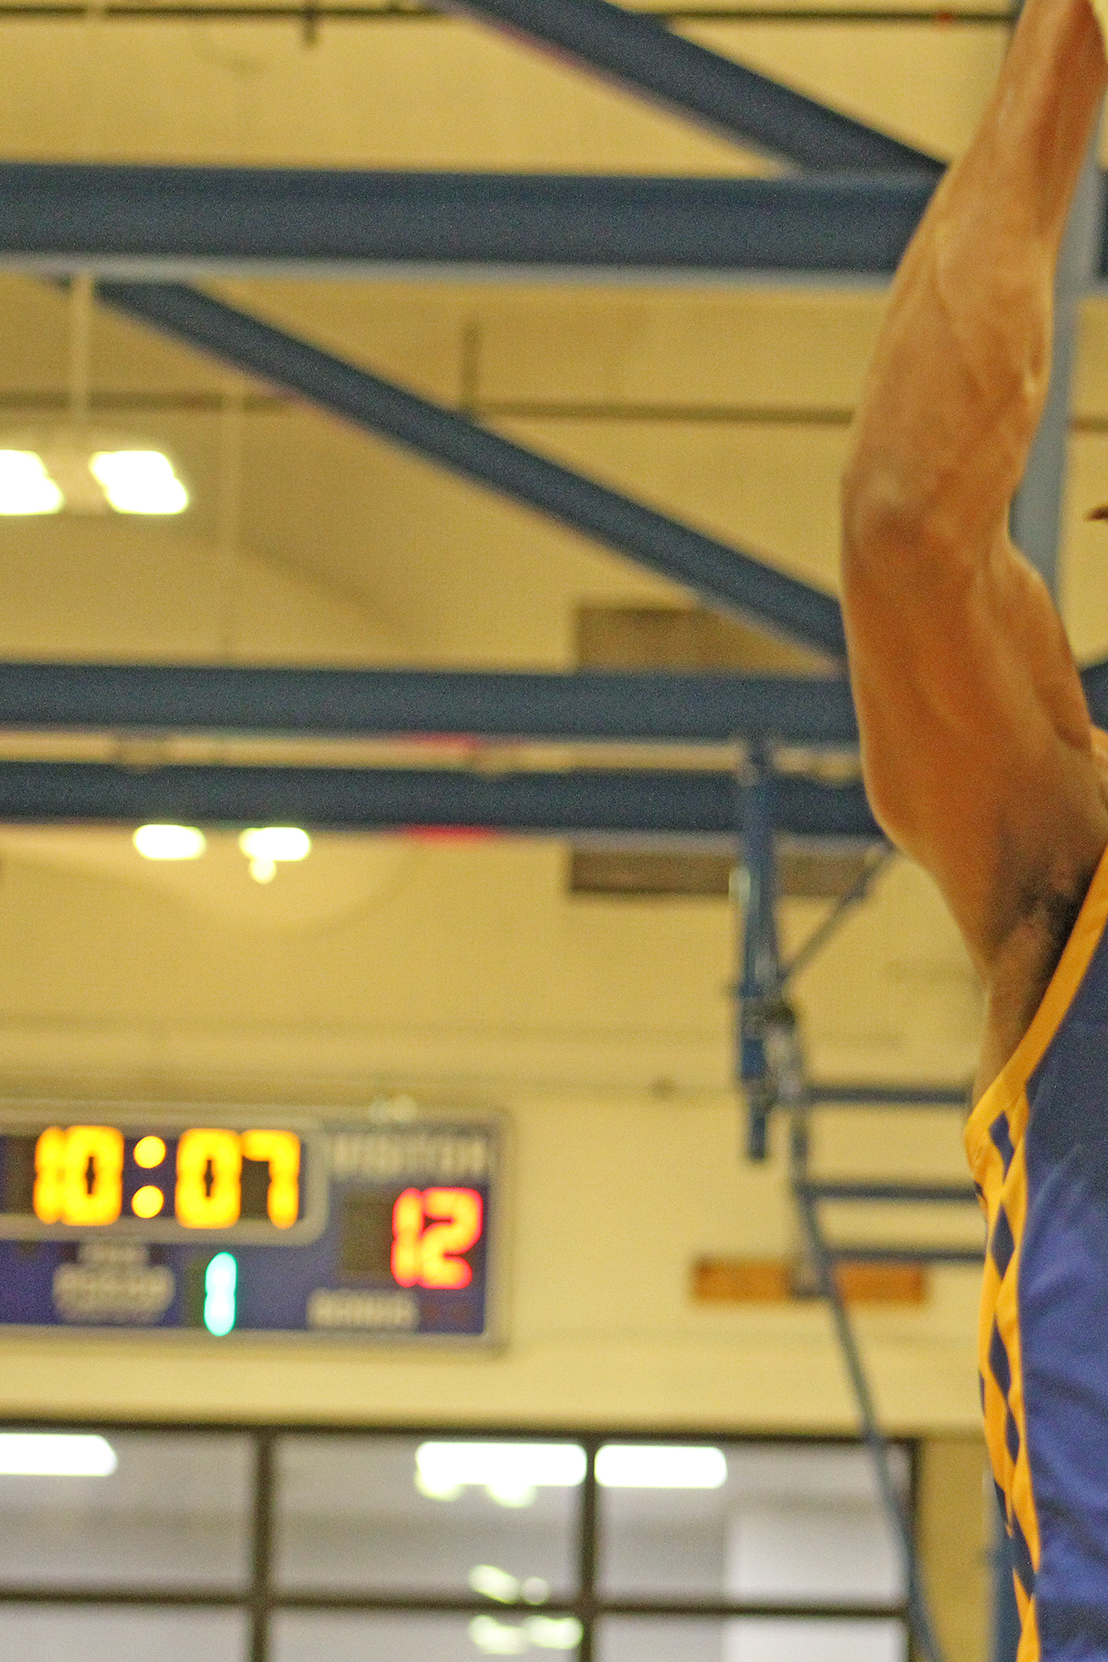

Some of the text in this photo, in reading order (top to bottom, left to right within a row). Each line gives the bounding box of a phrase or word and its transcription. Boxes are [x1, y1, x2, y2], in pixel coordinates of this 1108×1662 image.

[33, 1125, 300, 1229] 10:07
[390, 1187, 483, 1289] 12
[203, 1251, 238, 1337] 1
